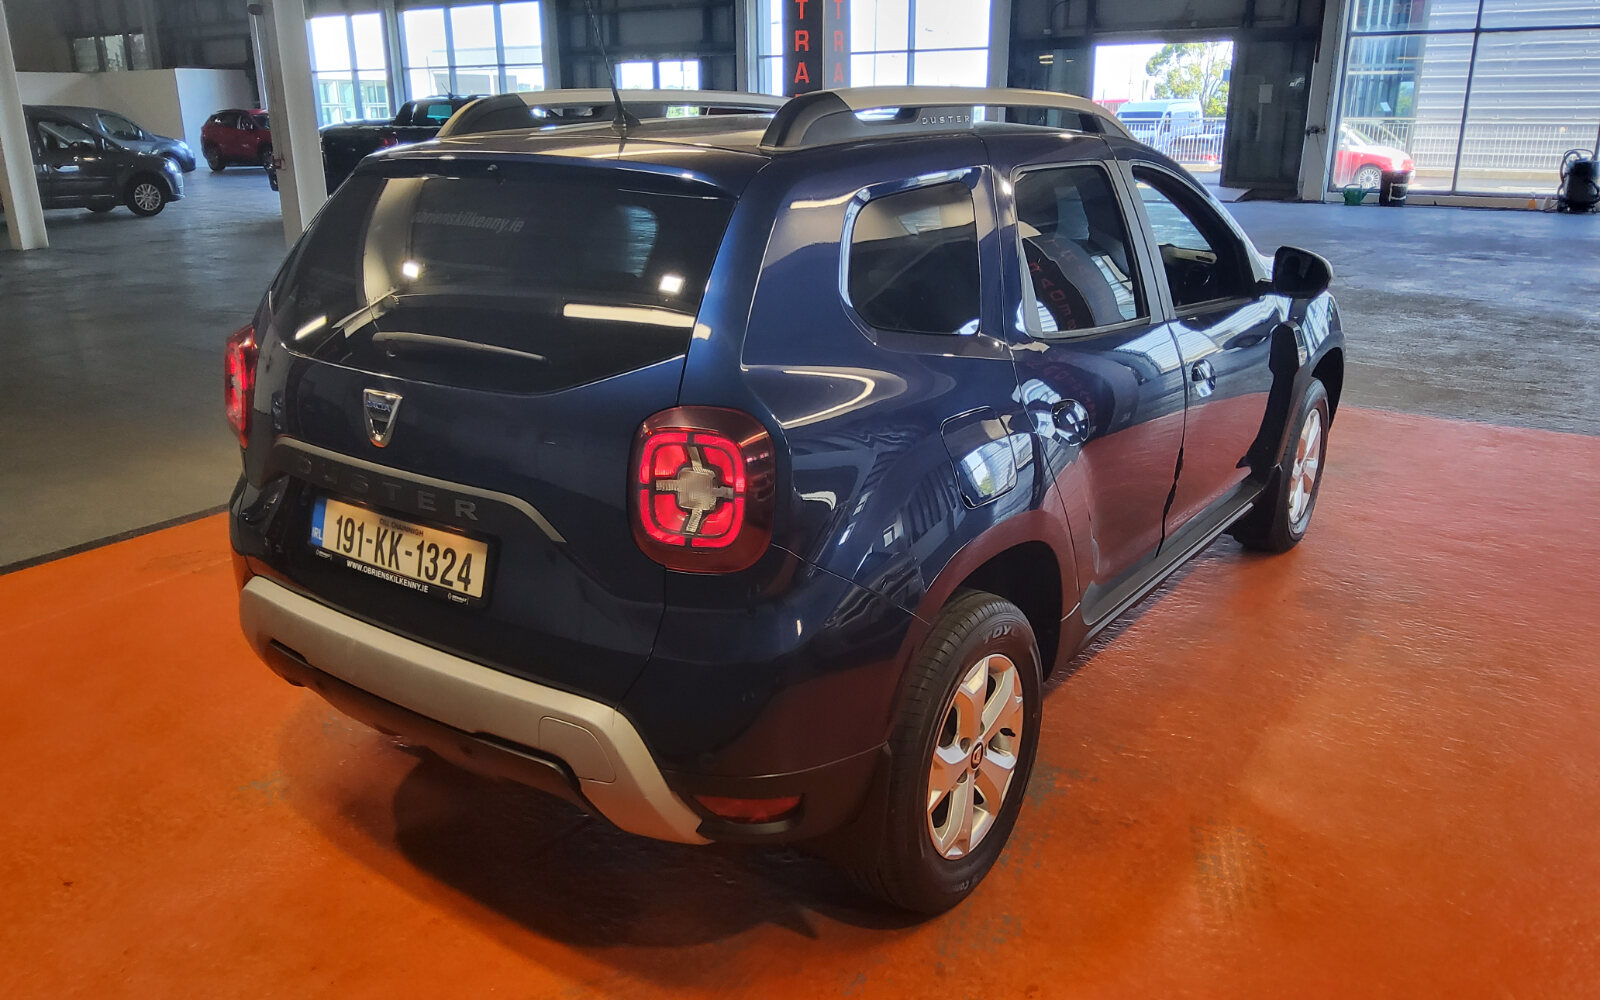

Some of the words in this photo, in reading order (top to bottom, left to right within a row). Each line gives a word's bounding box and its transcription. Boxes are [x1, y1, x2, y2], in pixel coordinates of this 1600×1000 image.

[794, 0, 810, 97] TRA
[921, 115, 970, 125] DUSTER
[299, 455, 479, 521] DUSTER
[312, 527, 322, 541] IRL
[336, 515, 472, 592] 191-KK-1324
[347, 560, 429, 593] WWW.OBRIENSKILKENNY.IE
